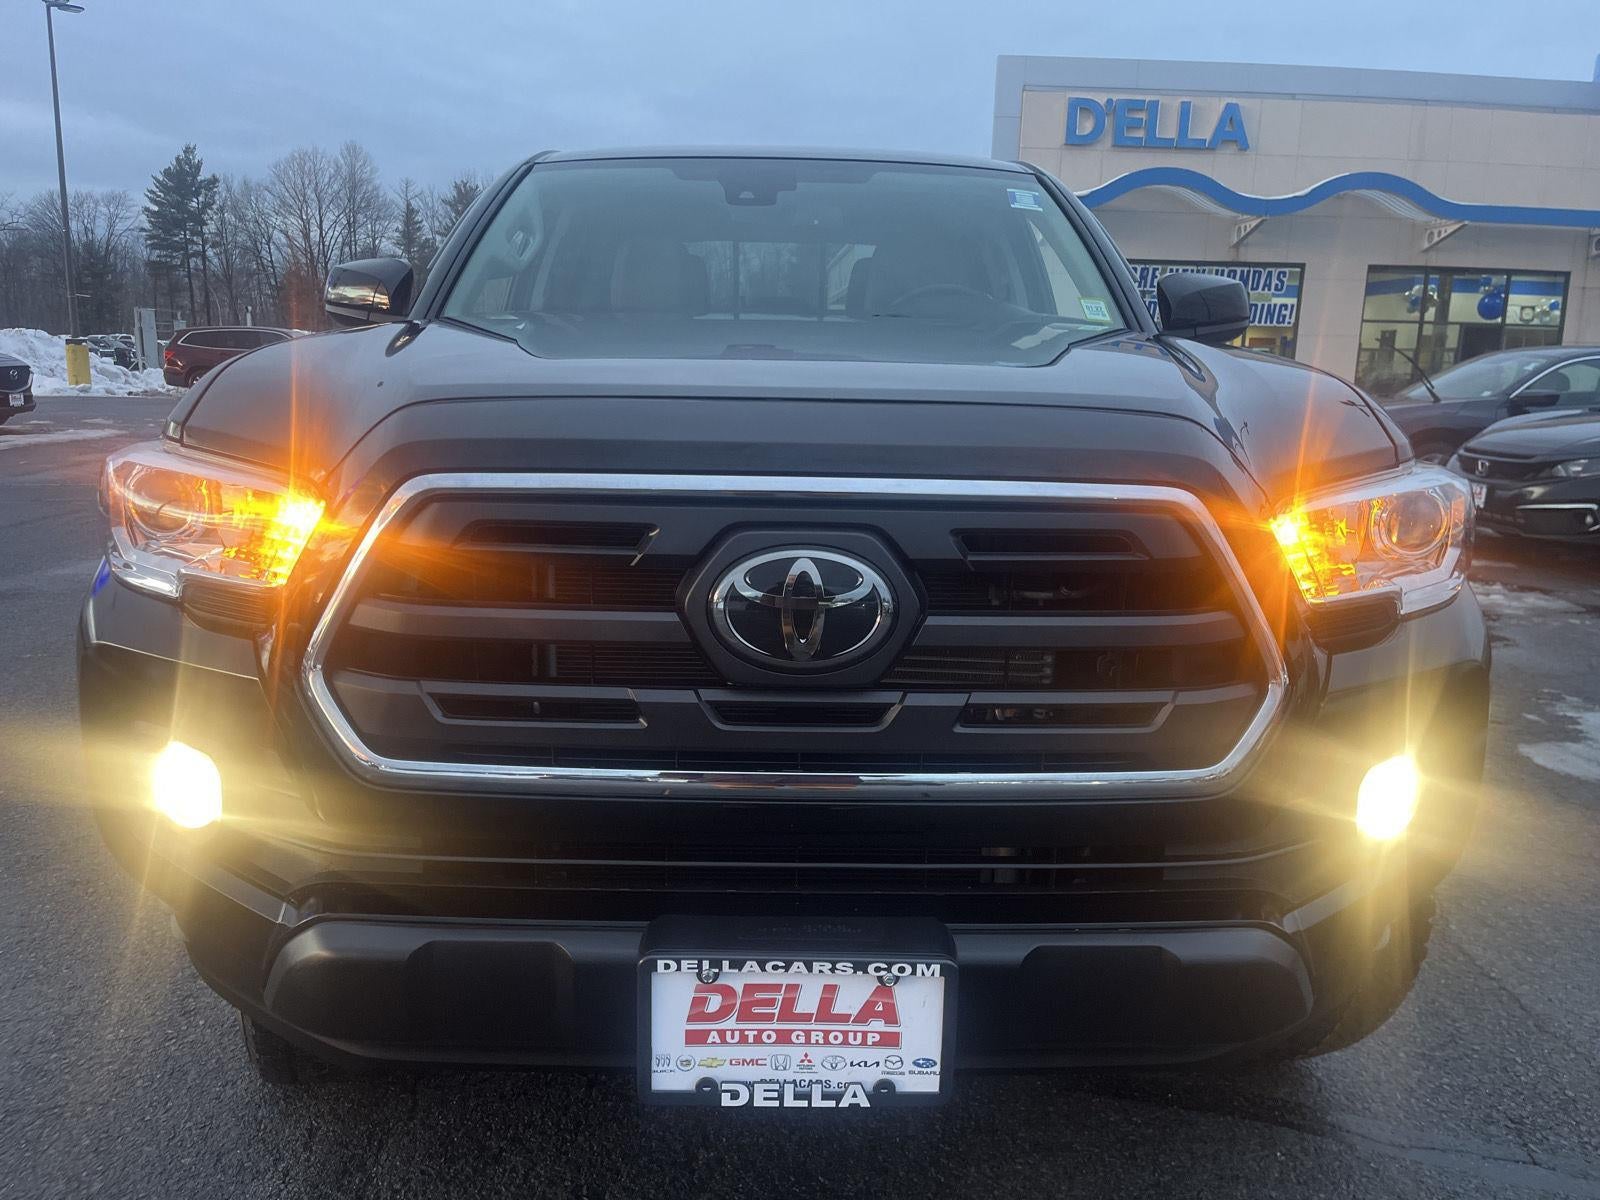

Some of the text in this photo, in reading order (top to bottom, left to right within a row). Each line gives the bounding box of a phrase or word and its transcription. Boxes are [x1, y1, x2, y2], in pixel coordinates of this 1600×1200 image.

[1065, 97, 1250, 151] D'ELLA
[657, 960, 941, 977] DELLACARS.COM
[686, 983, 901, 1027] DELLA
[706, 1030, 881, 1045] AUTO GROUP
[729, 1058, 768, 1067] GMC
[721, 1083, 870, 1108] DELLA
